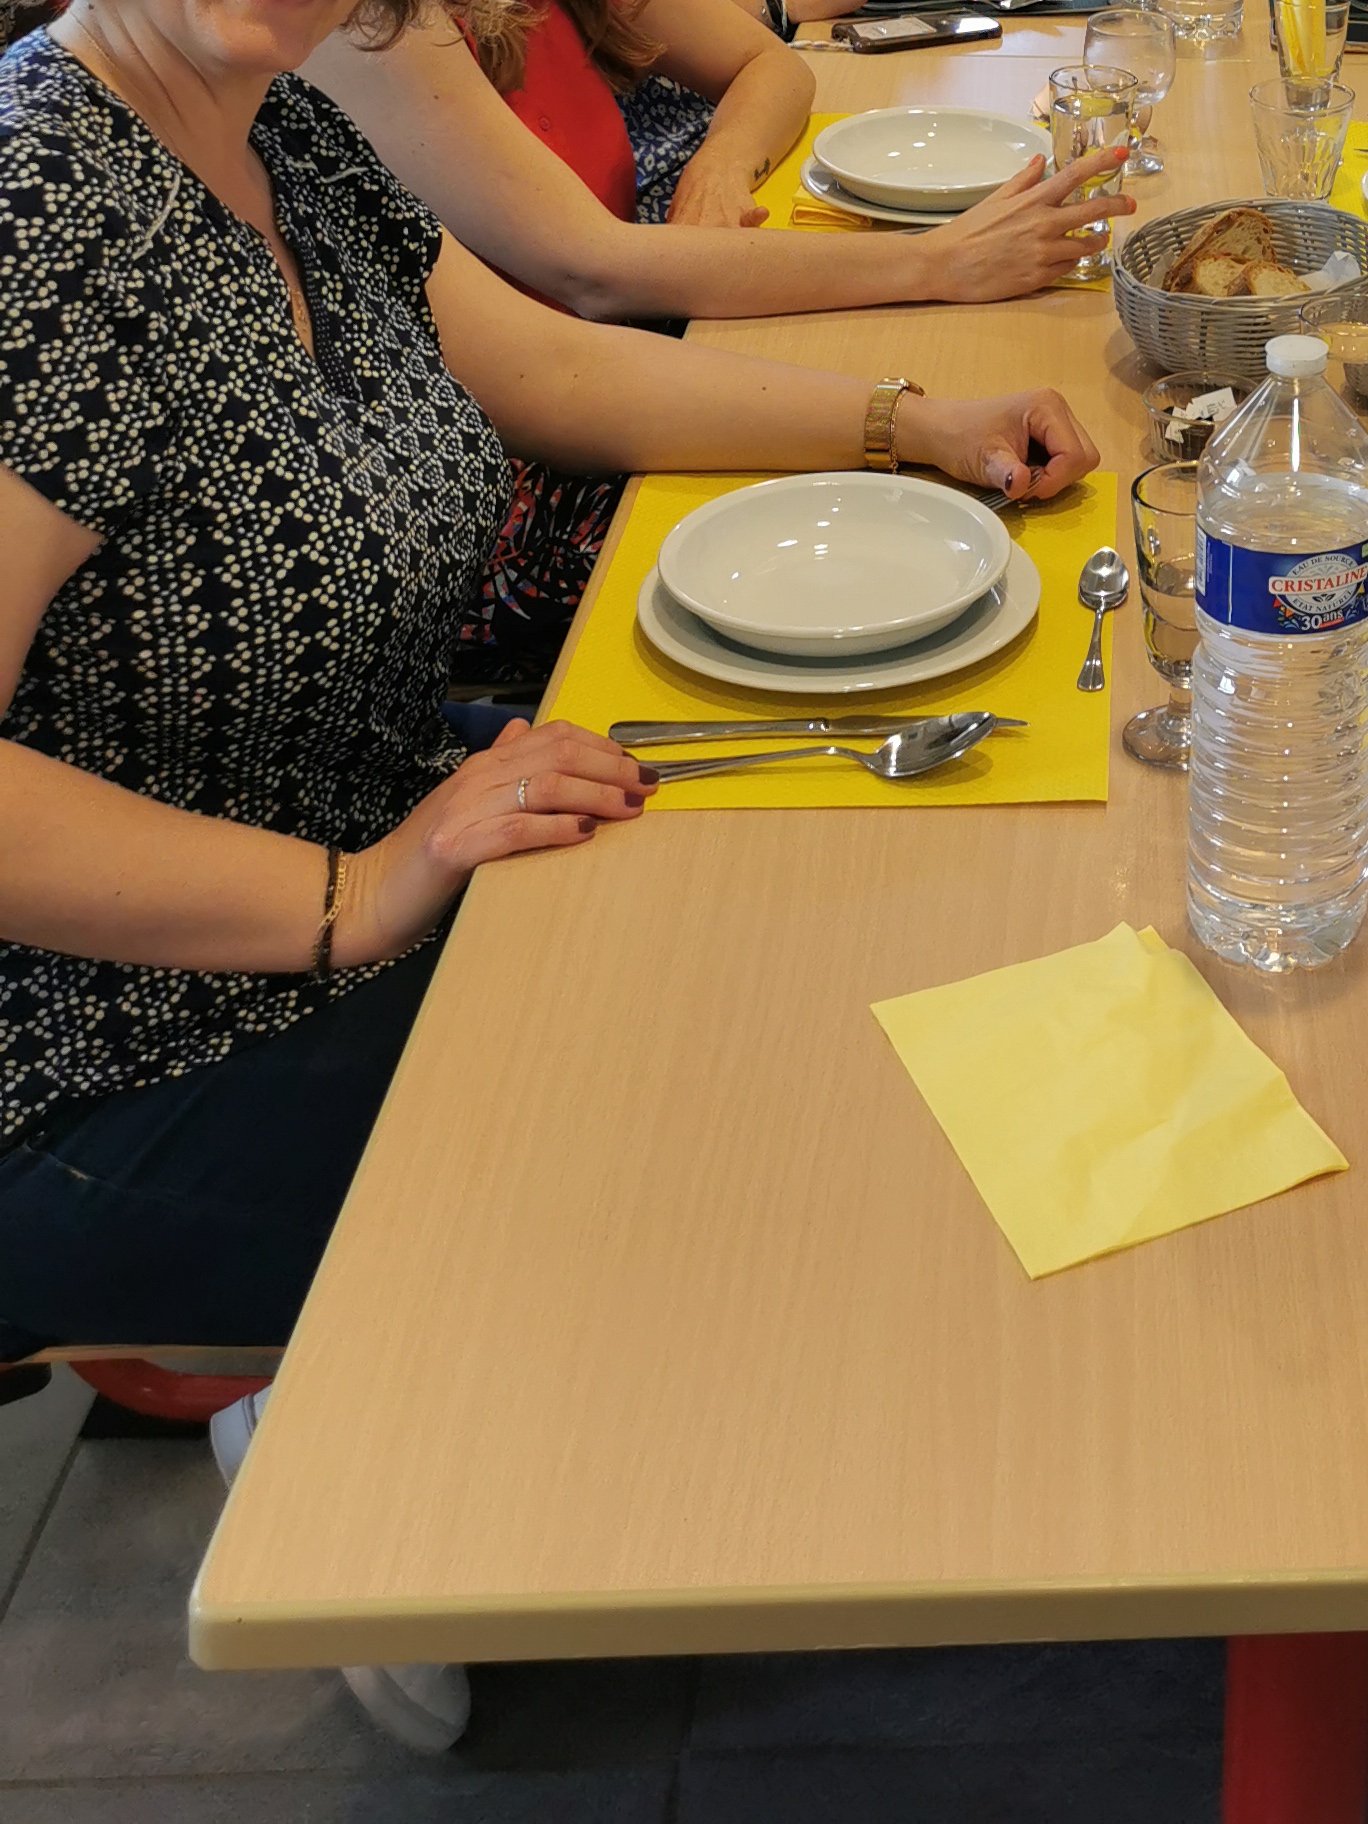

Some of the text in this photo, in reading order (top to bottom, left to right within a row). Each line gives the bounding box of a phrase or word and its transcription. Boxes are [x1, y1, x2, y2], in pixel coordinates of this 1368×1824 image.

[1292, 554, 1355, 576] EAU DE SOURCE
[1271, 566, 1367, 593] CRISTALINE
[1301, 614, 1323, 631] 30
[1322, 609, 1344, 622] ans
